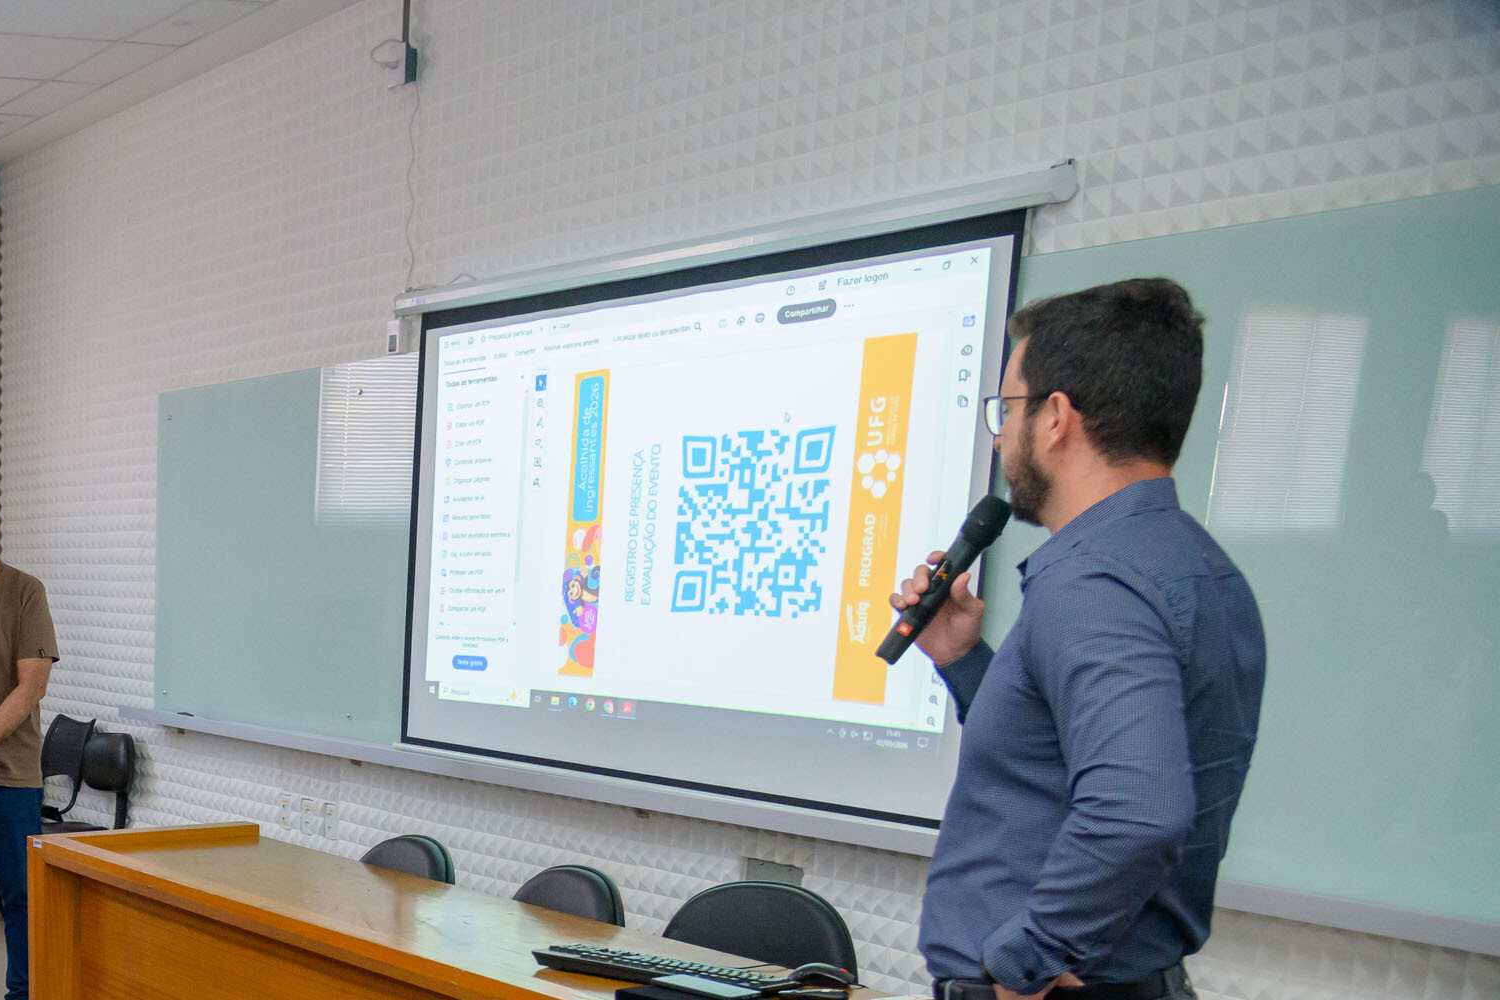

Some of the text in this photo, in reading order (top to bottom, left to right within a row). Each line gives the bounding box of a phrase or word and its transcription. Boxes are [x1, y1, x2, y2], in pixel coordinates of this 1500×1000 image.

[784, 304, 830, 318] Compartilhar
[837, 272, 889, 286] Fazer logon
[579, 408, 591, 491] Acolhida de
[584, 383, 600, 512] ingressantes 2026
[867, 396, 886, 447] UFG
[625, 449, 646, 602] REGISTRO DE PRESENÇA
[640, 443, 661, 606] E AVALIAÇÃO DO EVENTO
[859, 513, 875, 587] PROGRAD
